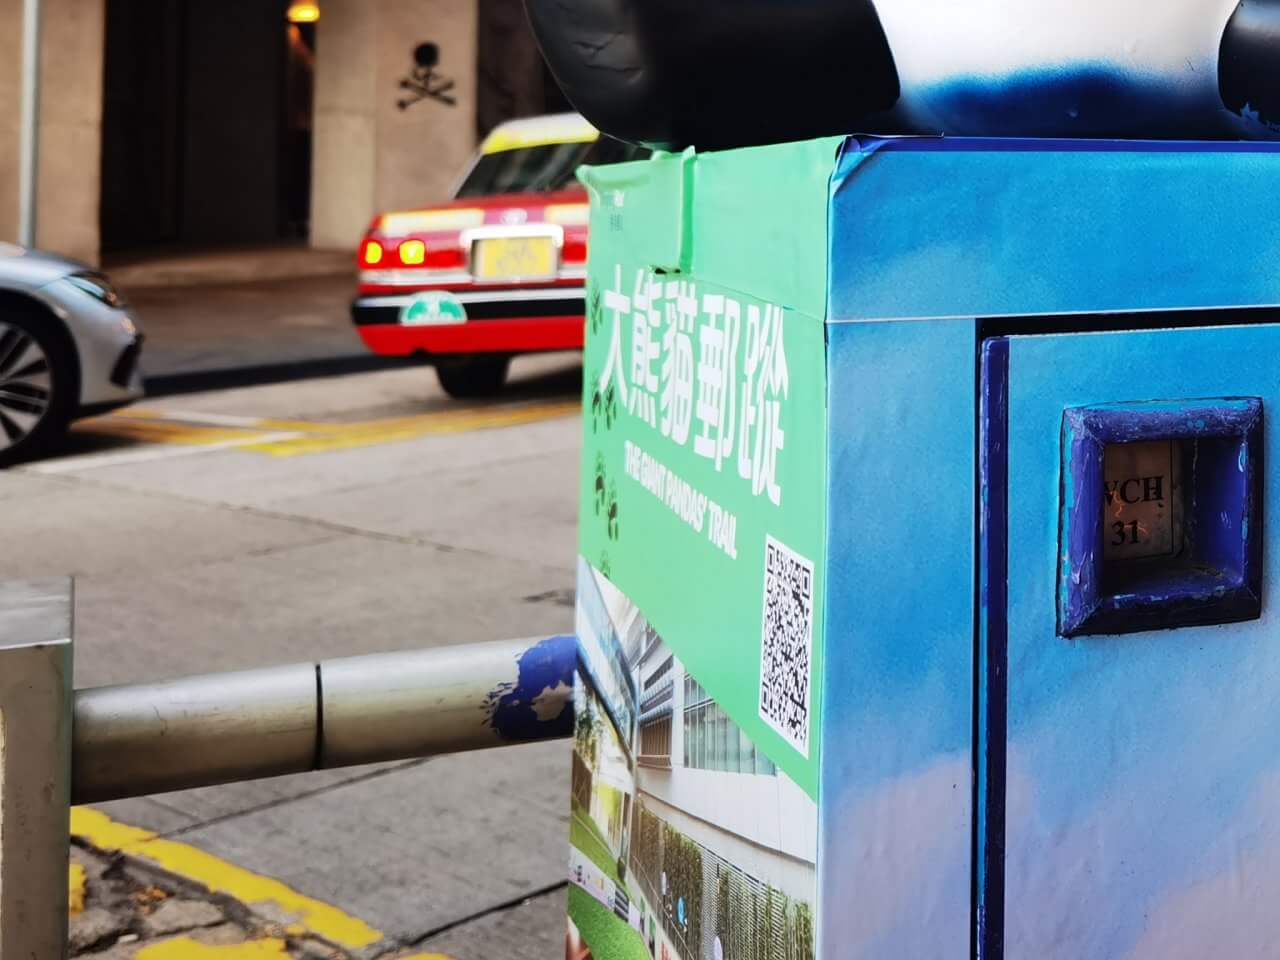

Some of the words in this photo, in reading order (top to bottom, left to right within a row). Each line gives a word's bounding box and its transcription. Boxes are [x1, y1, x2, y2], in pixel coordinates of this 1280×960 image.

[599, 263, 789, 506] 大熊貓郵蹤
[708, 499, 738, 561] TRAIL
[1111, 520, 1140, 547] 31
